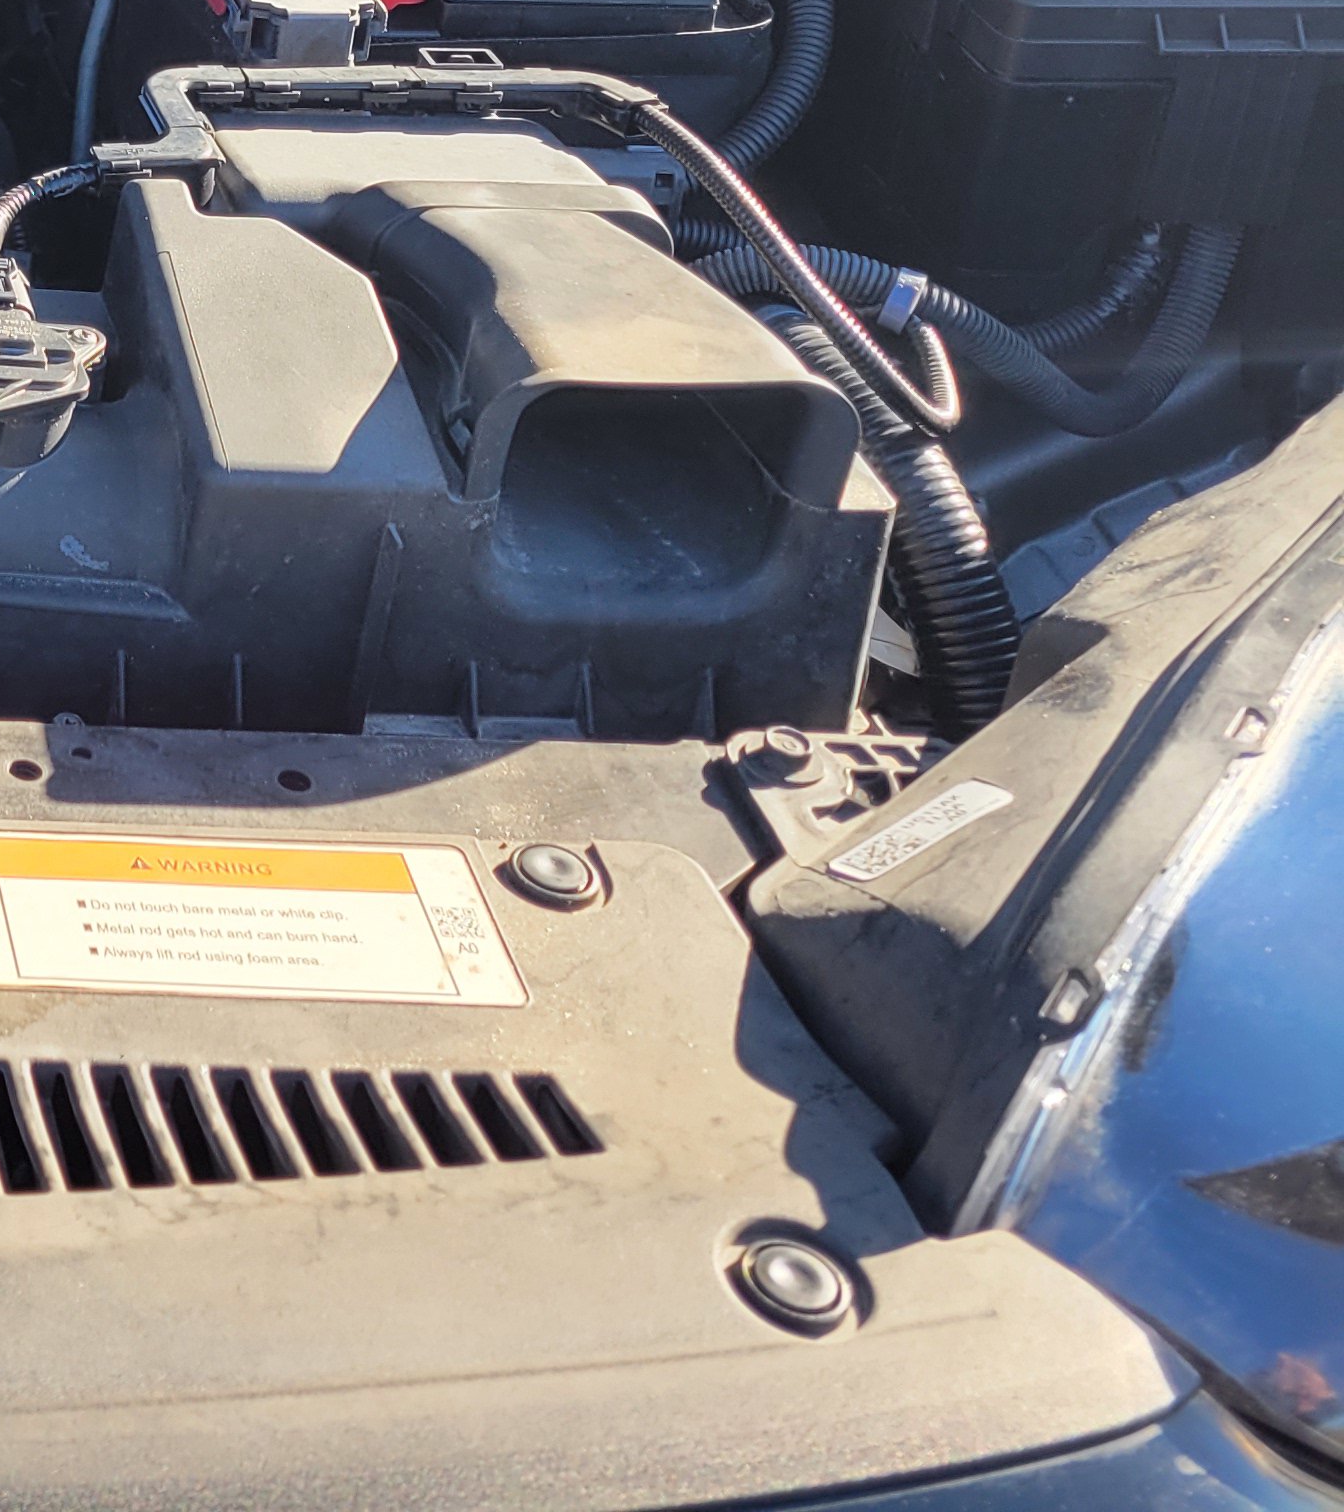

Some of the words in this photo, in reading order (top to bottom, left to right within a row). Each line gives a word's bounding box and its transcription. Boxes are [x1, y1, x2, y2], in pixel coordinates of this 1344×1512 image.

[157, 858, 273, 876] WARNING
[90, 899, 110, 910] Do
[114, 901, 137, 912] not
[140, 901, 179, 914] touch
[182, 903, 214, 915] bare
[218, 906, 256, 917] metal
[260, 908, 274, 918] or
[279, 907, 316, 919] white
[319, 910, 349, 923] clip.
[96, 922, 135, 934] Metal
[139, 925, 162, 936] rod
[166, 927, 196, 939] gets
[200, 927, 223, 938] hot
[227, 929, 253, 940] and
[257, 931, 282, 941] can
[322, 932, 364, 944] hand.
[104, 946, 153, 962] Always
[157, 948, 173, 960] lift
[178, 950, 201, 961] rod
[205, 952, 243, 965] using
[247, 952, 283, 965] foam
[287, 957, 325, 967] area.
